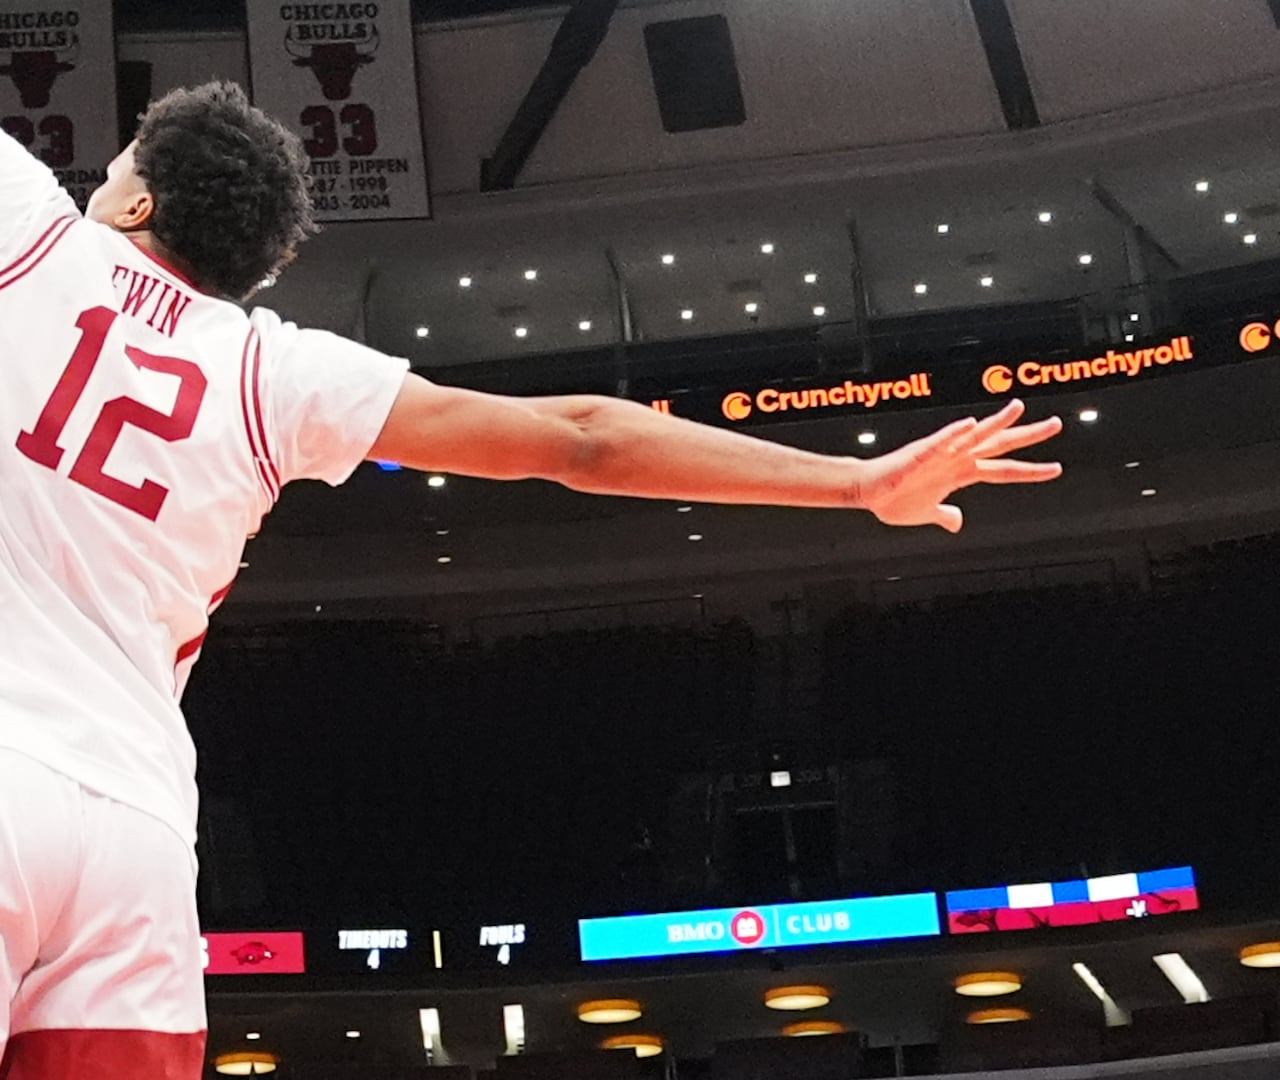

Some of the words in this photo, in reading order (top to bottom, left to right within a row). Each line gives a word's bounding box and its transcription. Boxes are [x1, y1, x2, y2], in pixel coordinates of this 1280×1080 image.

[280, 3, 378, 20] CHICAGO
[297, 23, 366, 40] BULLS
[300, 103, 378, 158] 33
[349, 159, 408, 174] PIPPEN
[349, 177, 388, 191] 1998
[352, 196, 390, 209] 2004
[1017, 337, 1192, 386] Crunchyroll
[756, 373, 931, 413] Crunchyroll
[15, 305, 208, 522] 12
[480, 924, 526, 946] FOULS
[667, 921, 725, 943] BMO
[787, 912, 851, 933] CLUB
[339, 930, 407, 949] TIMEOUTS
[366, 949, 380, 969] 4
[497, 945, 510, 965] 4
